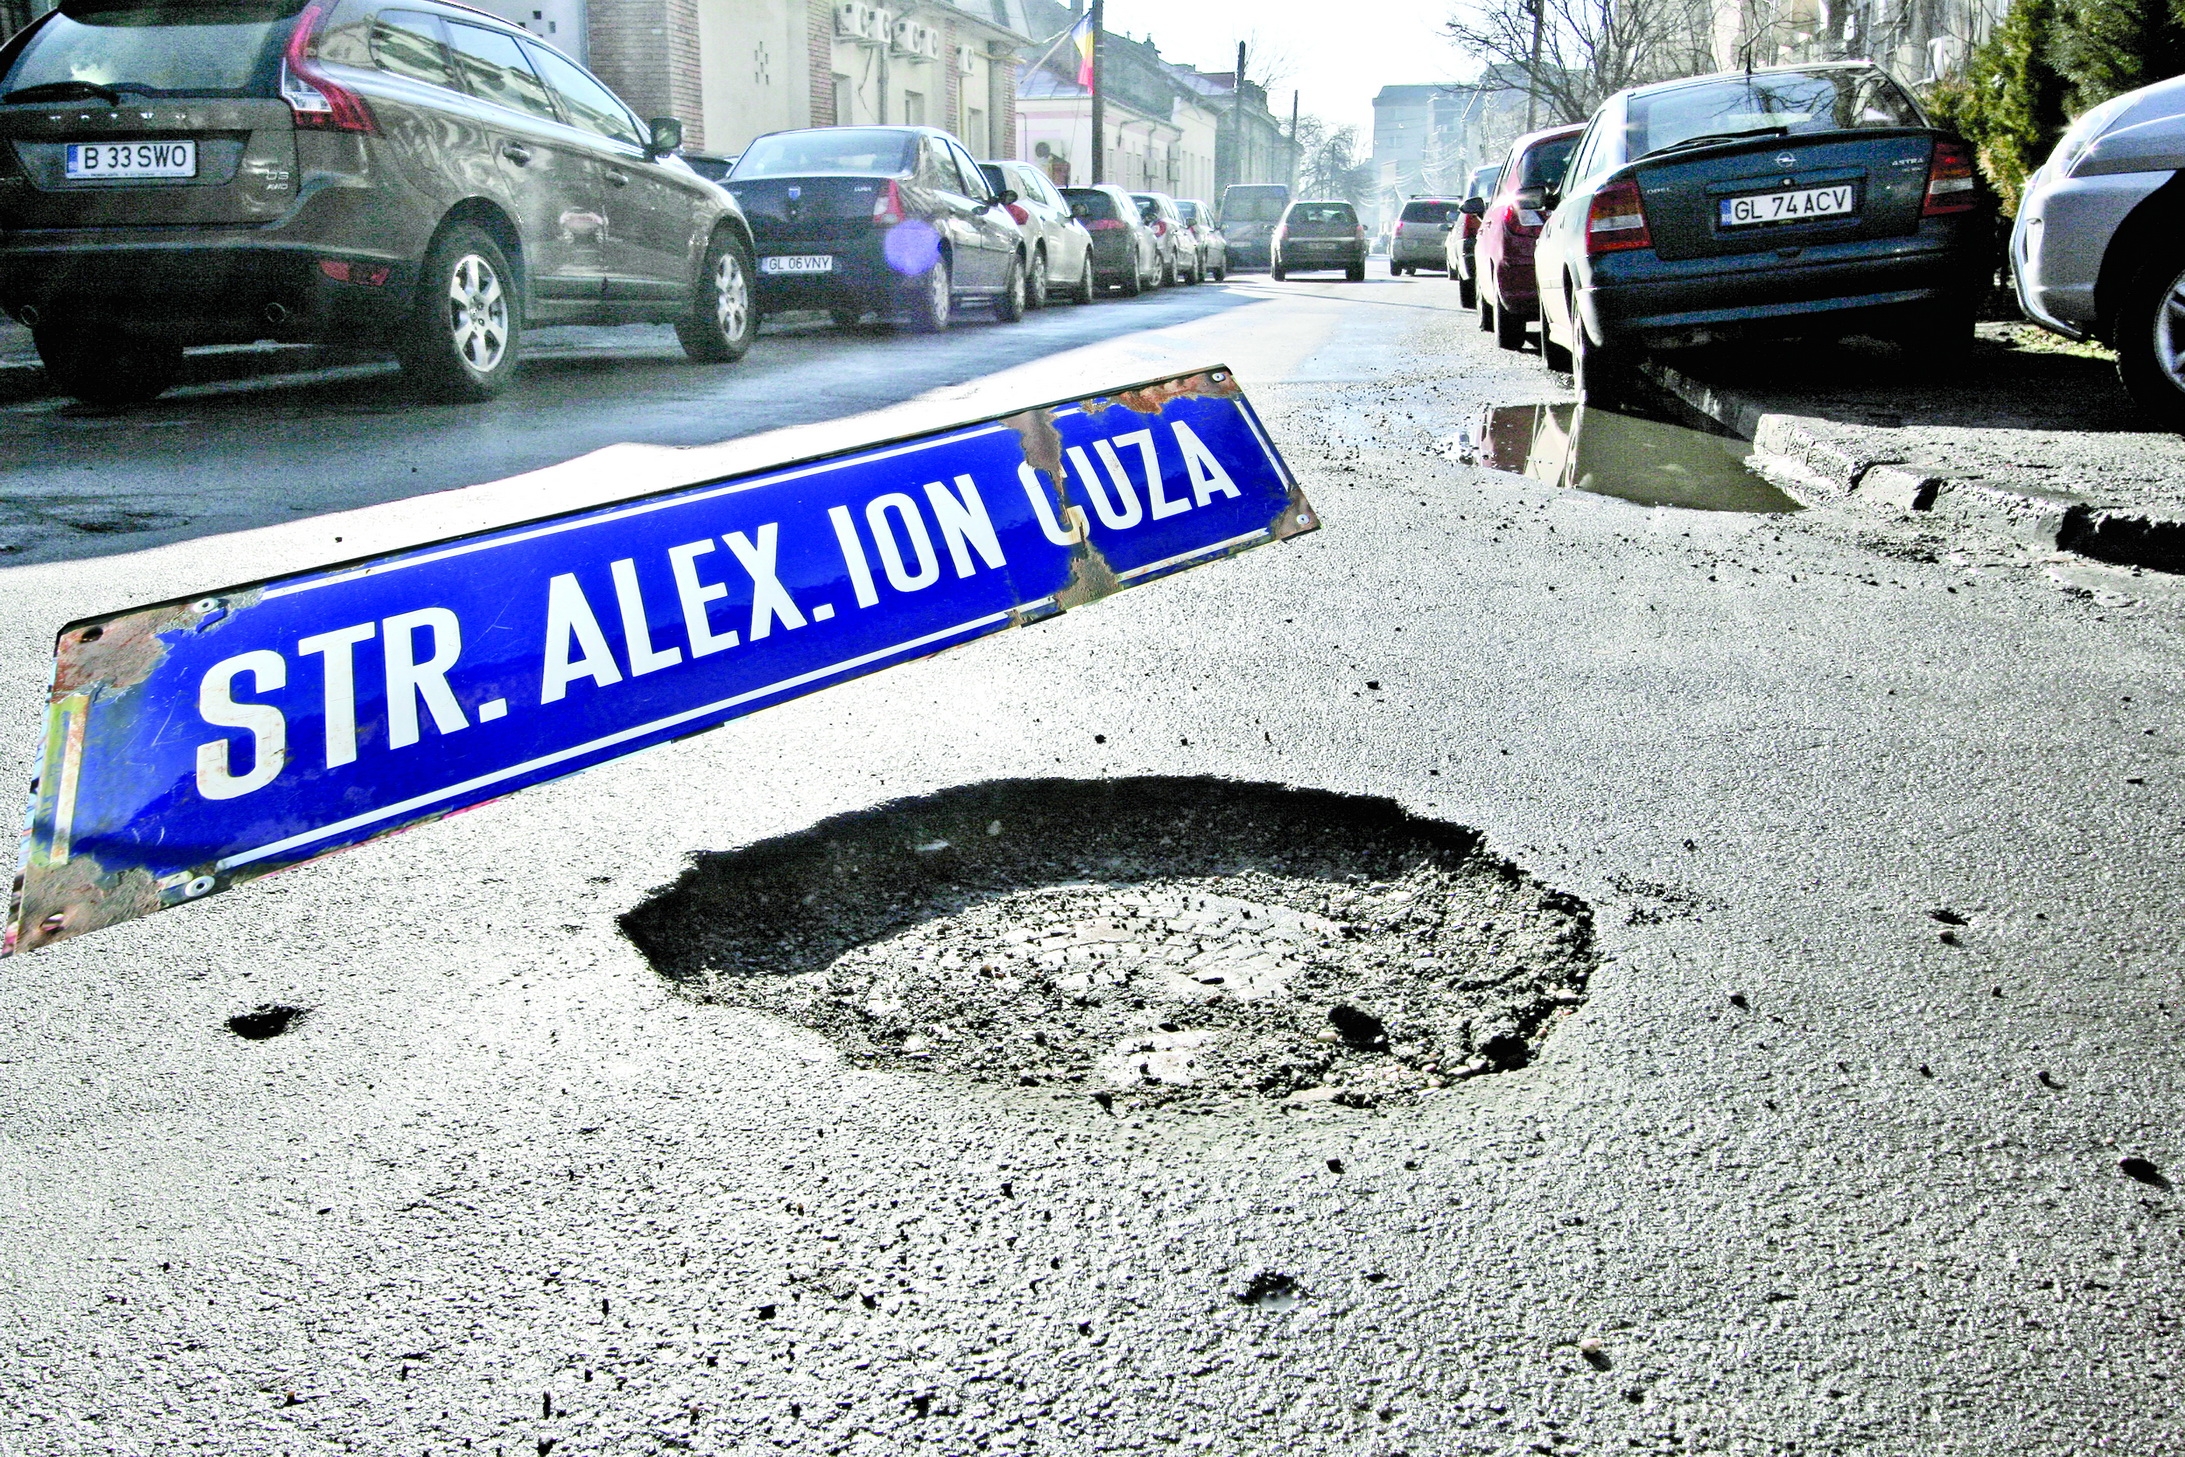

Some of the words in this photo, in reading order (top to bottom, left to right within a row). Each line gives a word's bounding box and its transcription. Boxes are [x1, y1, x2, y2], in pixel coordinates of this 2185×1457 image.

[84, 147, 99, 169] B
[107, 146, 132, 168] 33
[137, 145, 187, 168] SWO
[1734, 200, 1763, 220] GL
[1772, 195, 1798, 217] 74
[1804, 188, 1847, 214] ACV
[769, 258, 784, 270] GL
[196, 607, 508, 801] STR.
[540, 523, 835, 705] ALEX.
[828, 473, 1007, 609] ION
[1016, 419, 1242, 547] CUZA
